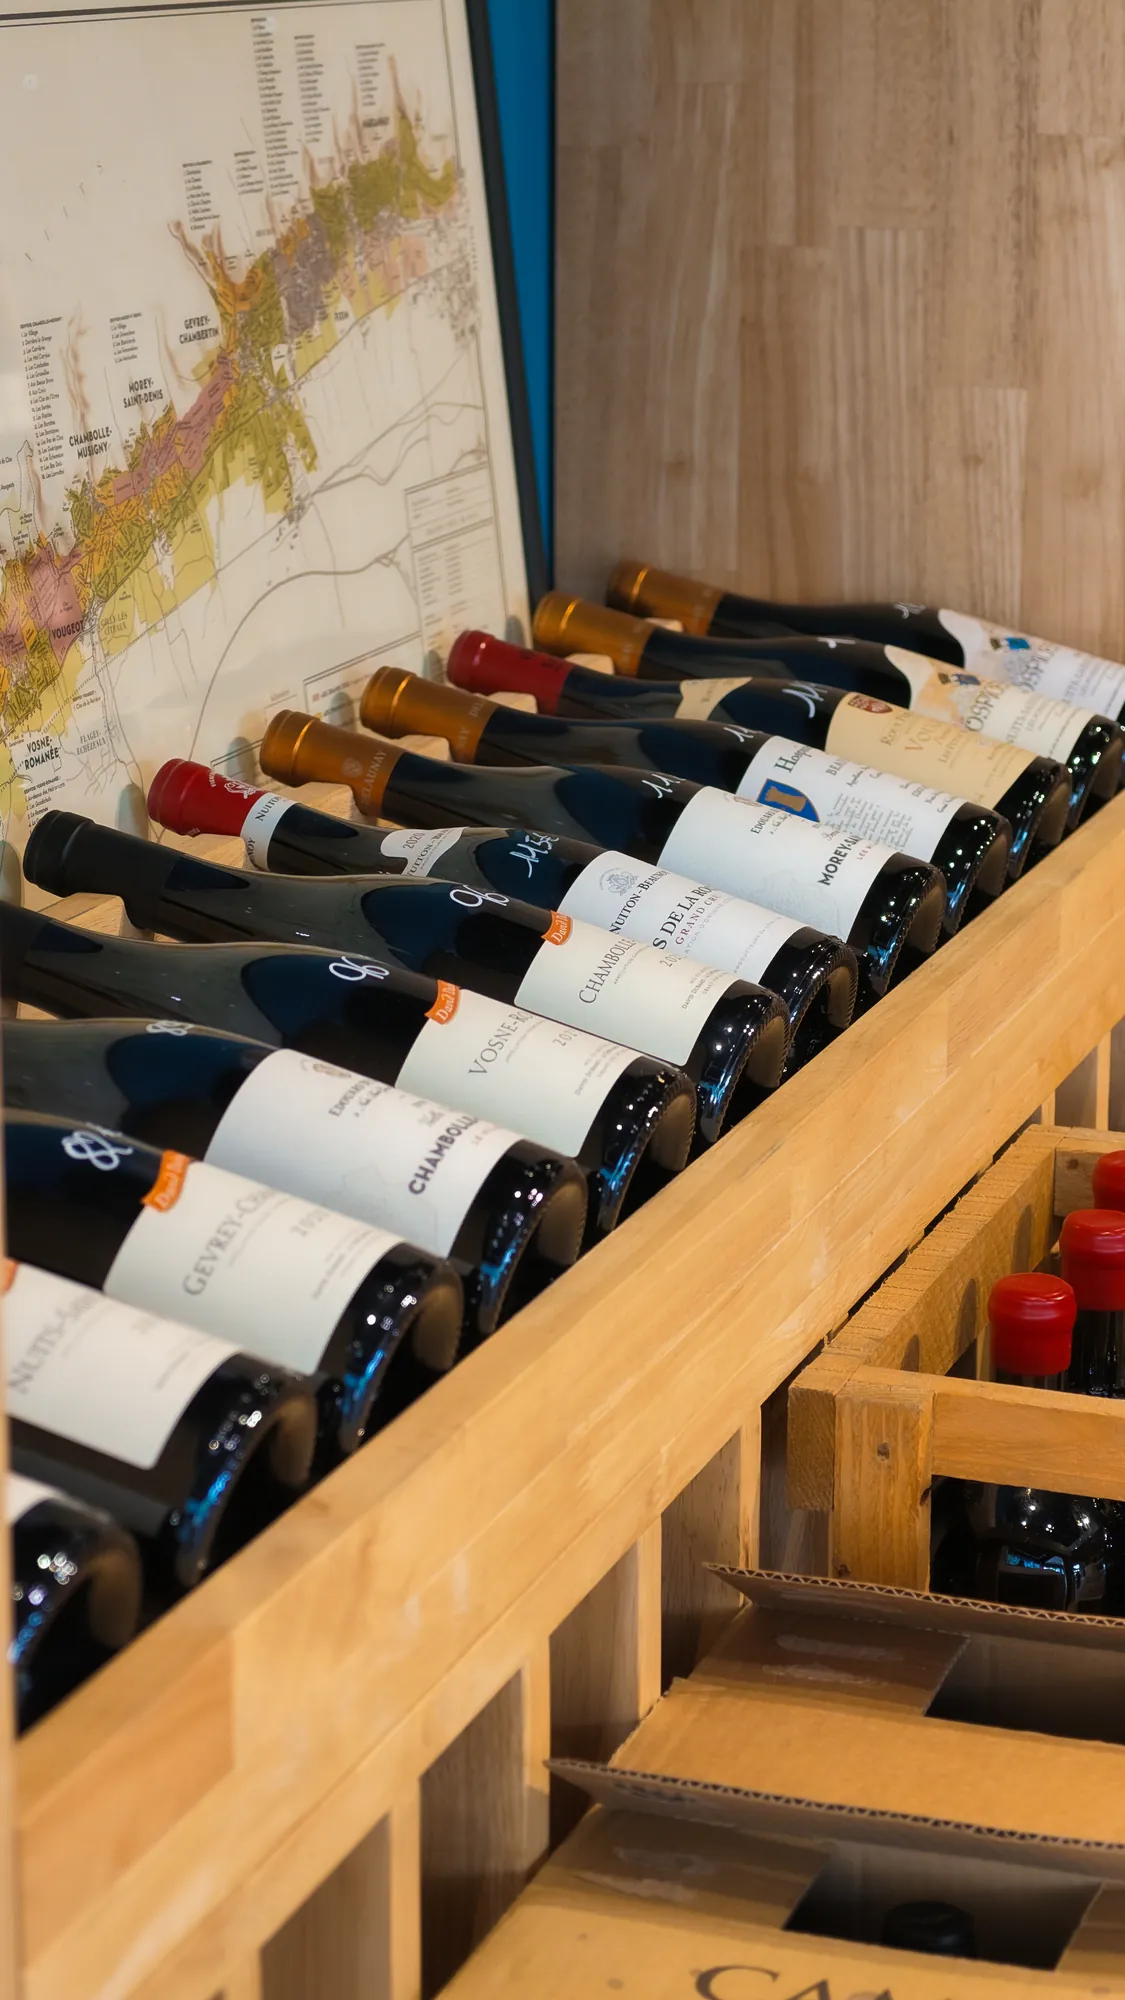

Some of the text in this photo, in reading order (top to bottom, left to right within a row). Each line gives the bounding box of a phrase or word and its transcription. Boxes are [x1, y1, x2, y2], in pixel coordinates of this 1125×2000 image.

[123, 389, 163, 409] SAINT-DENIS
[69, 427, 112, 447] CHAMBOLLE-
[77, 441, 108, 460] MUSIGNY
[52, 620, 84, 640] VOUGEOT
[27, 736, 53, 754] VOSNE-
[25, 747, 60, 770] ROMANÉE
[660, 911, 684, 937] DE
[677, 894, 700, 911] LA
[675, 907, 706, 945] GRAND
